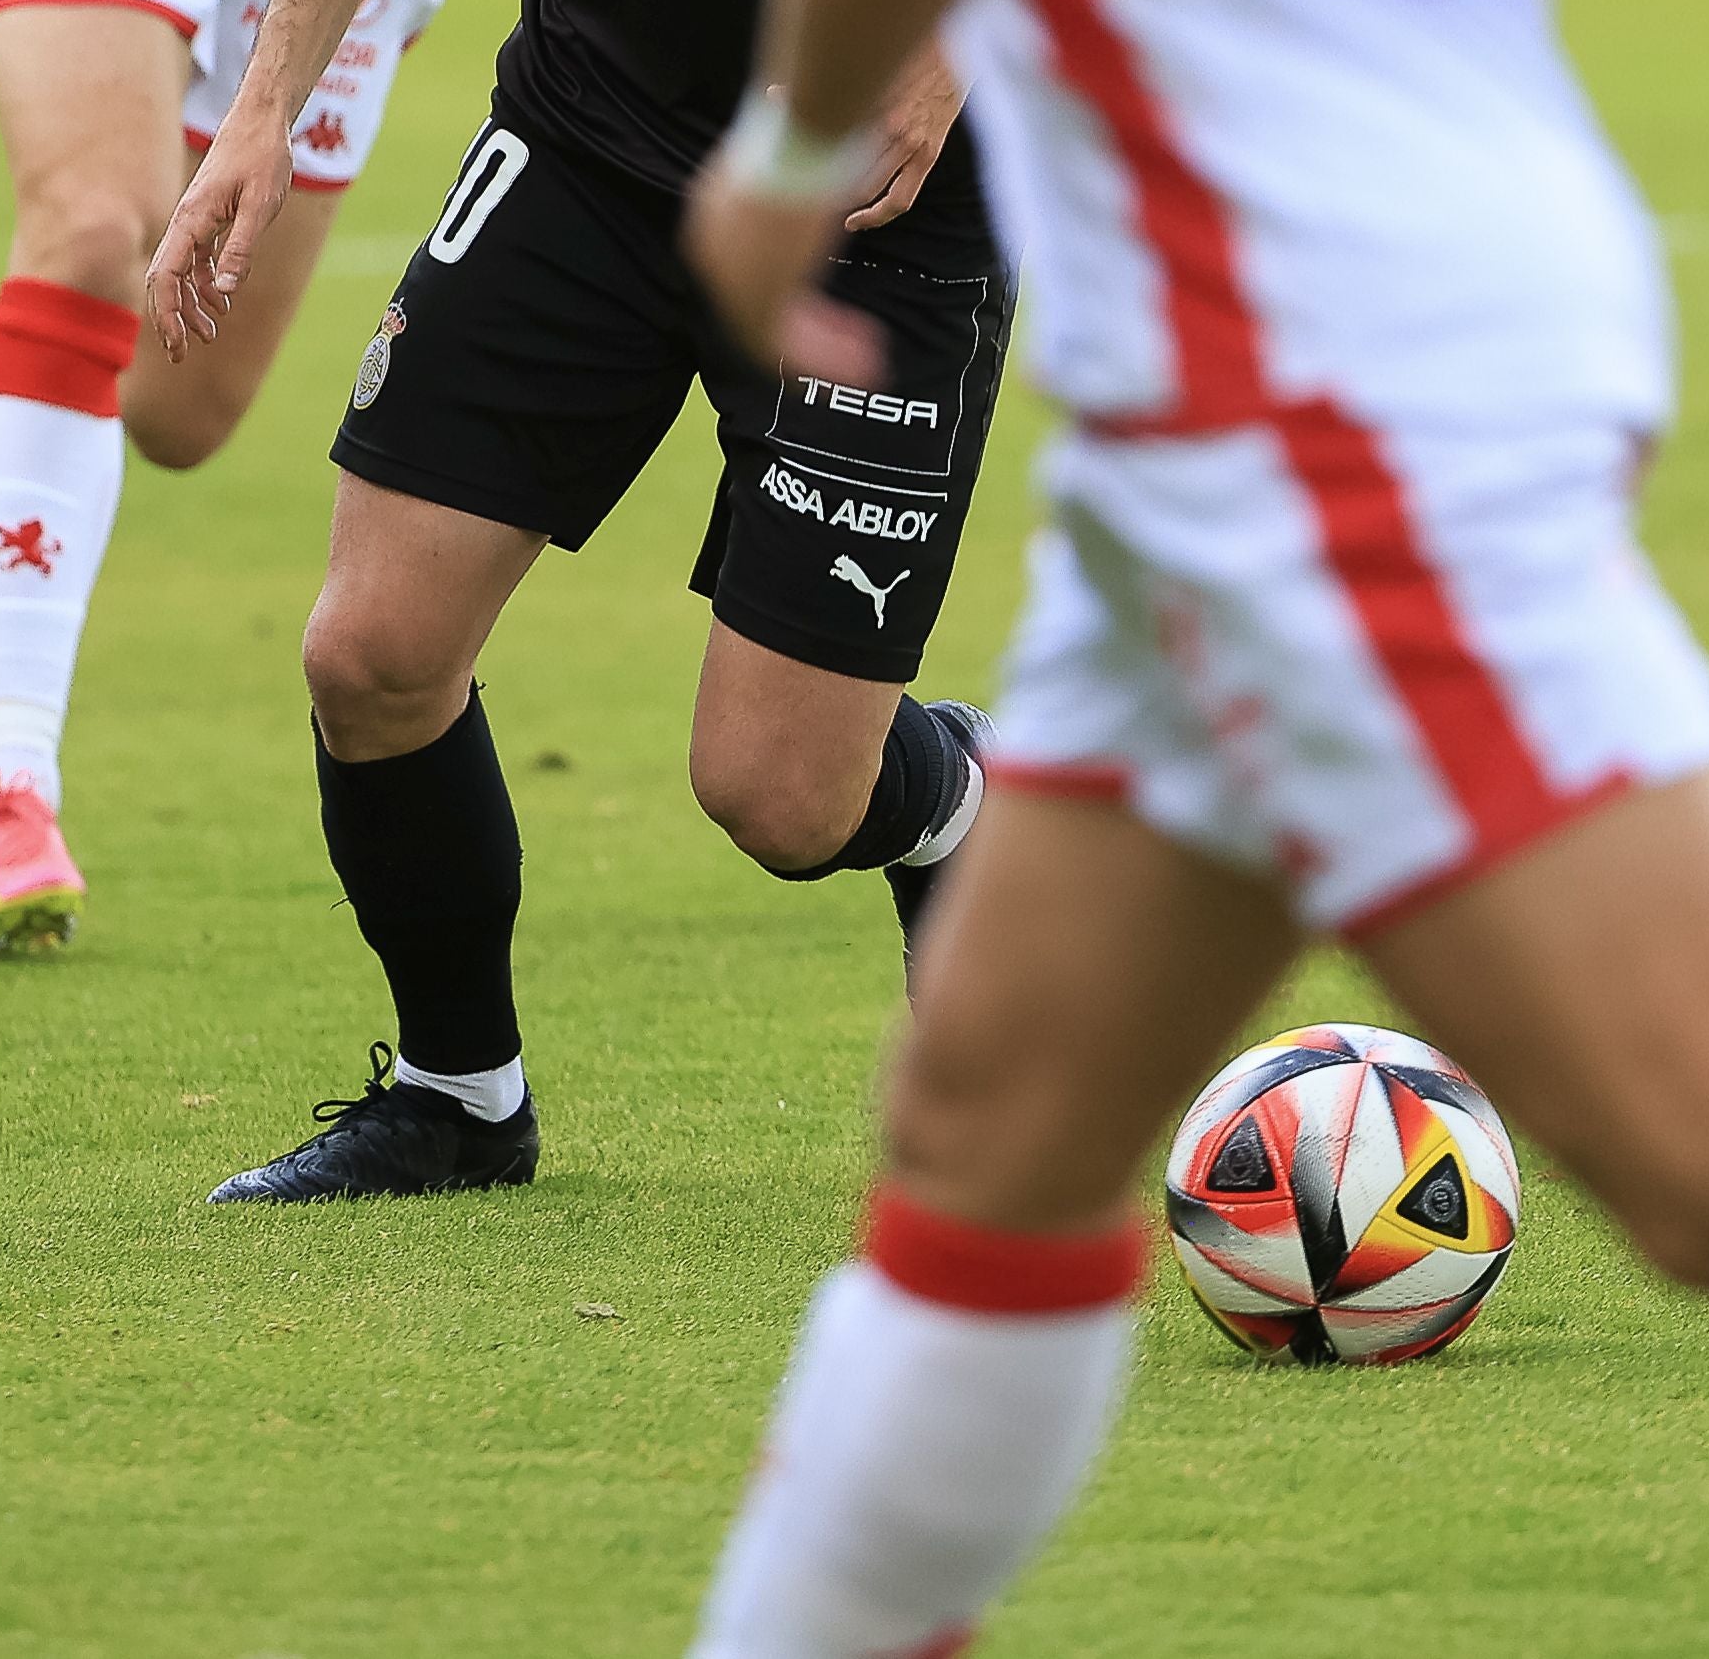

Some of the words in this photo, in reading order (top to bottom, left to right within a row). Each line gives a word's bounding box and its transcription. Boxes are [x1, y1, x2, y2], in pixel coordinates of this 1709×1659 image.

[798, 376, 938, 429] TESA
[760, 463, 824, 522] ASSA
[829, 499, 938, 542] ABLOY
